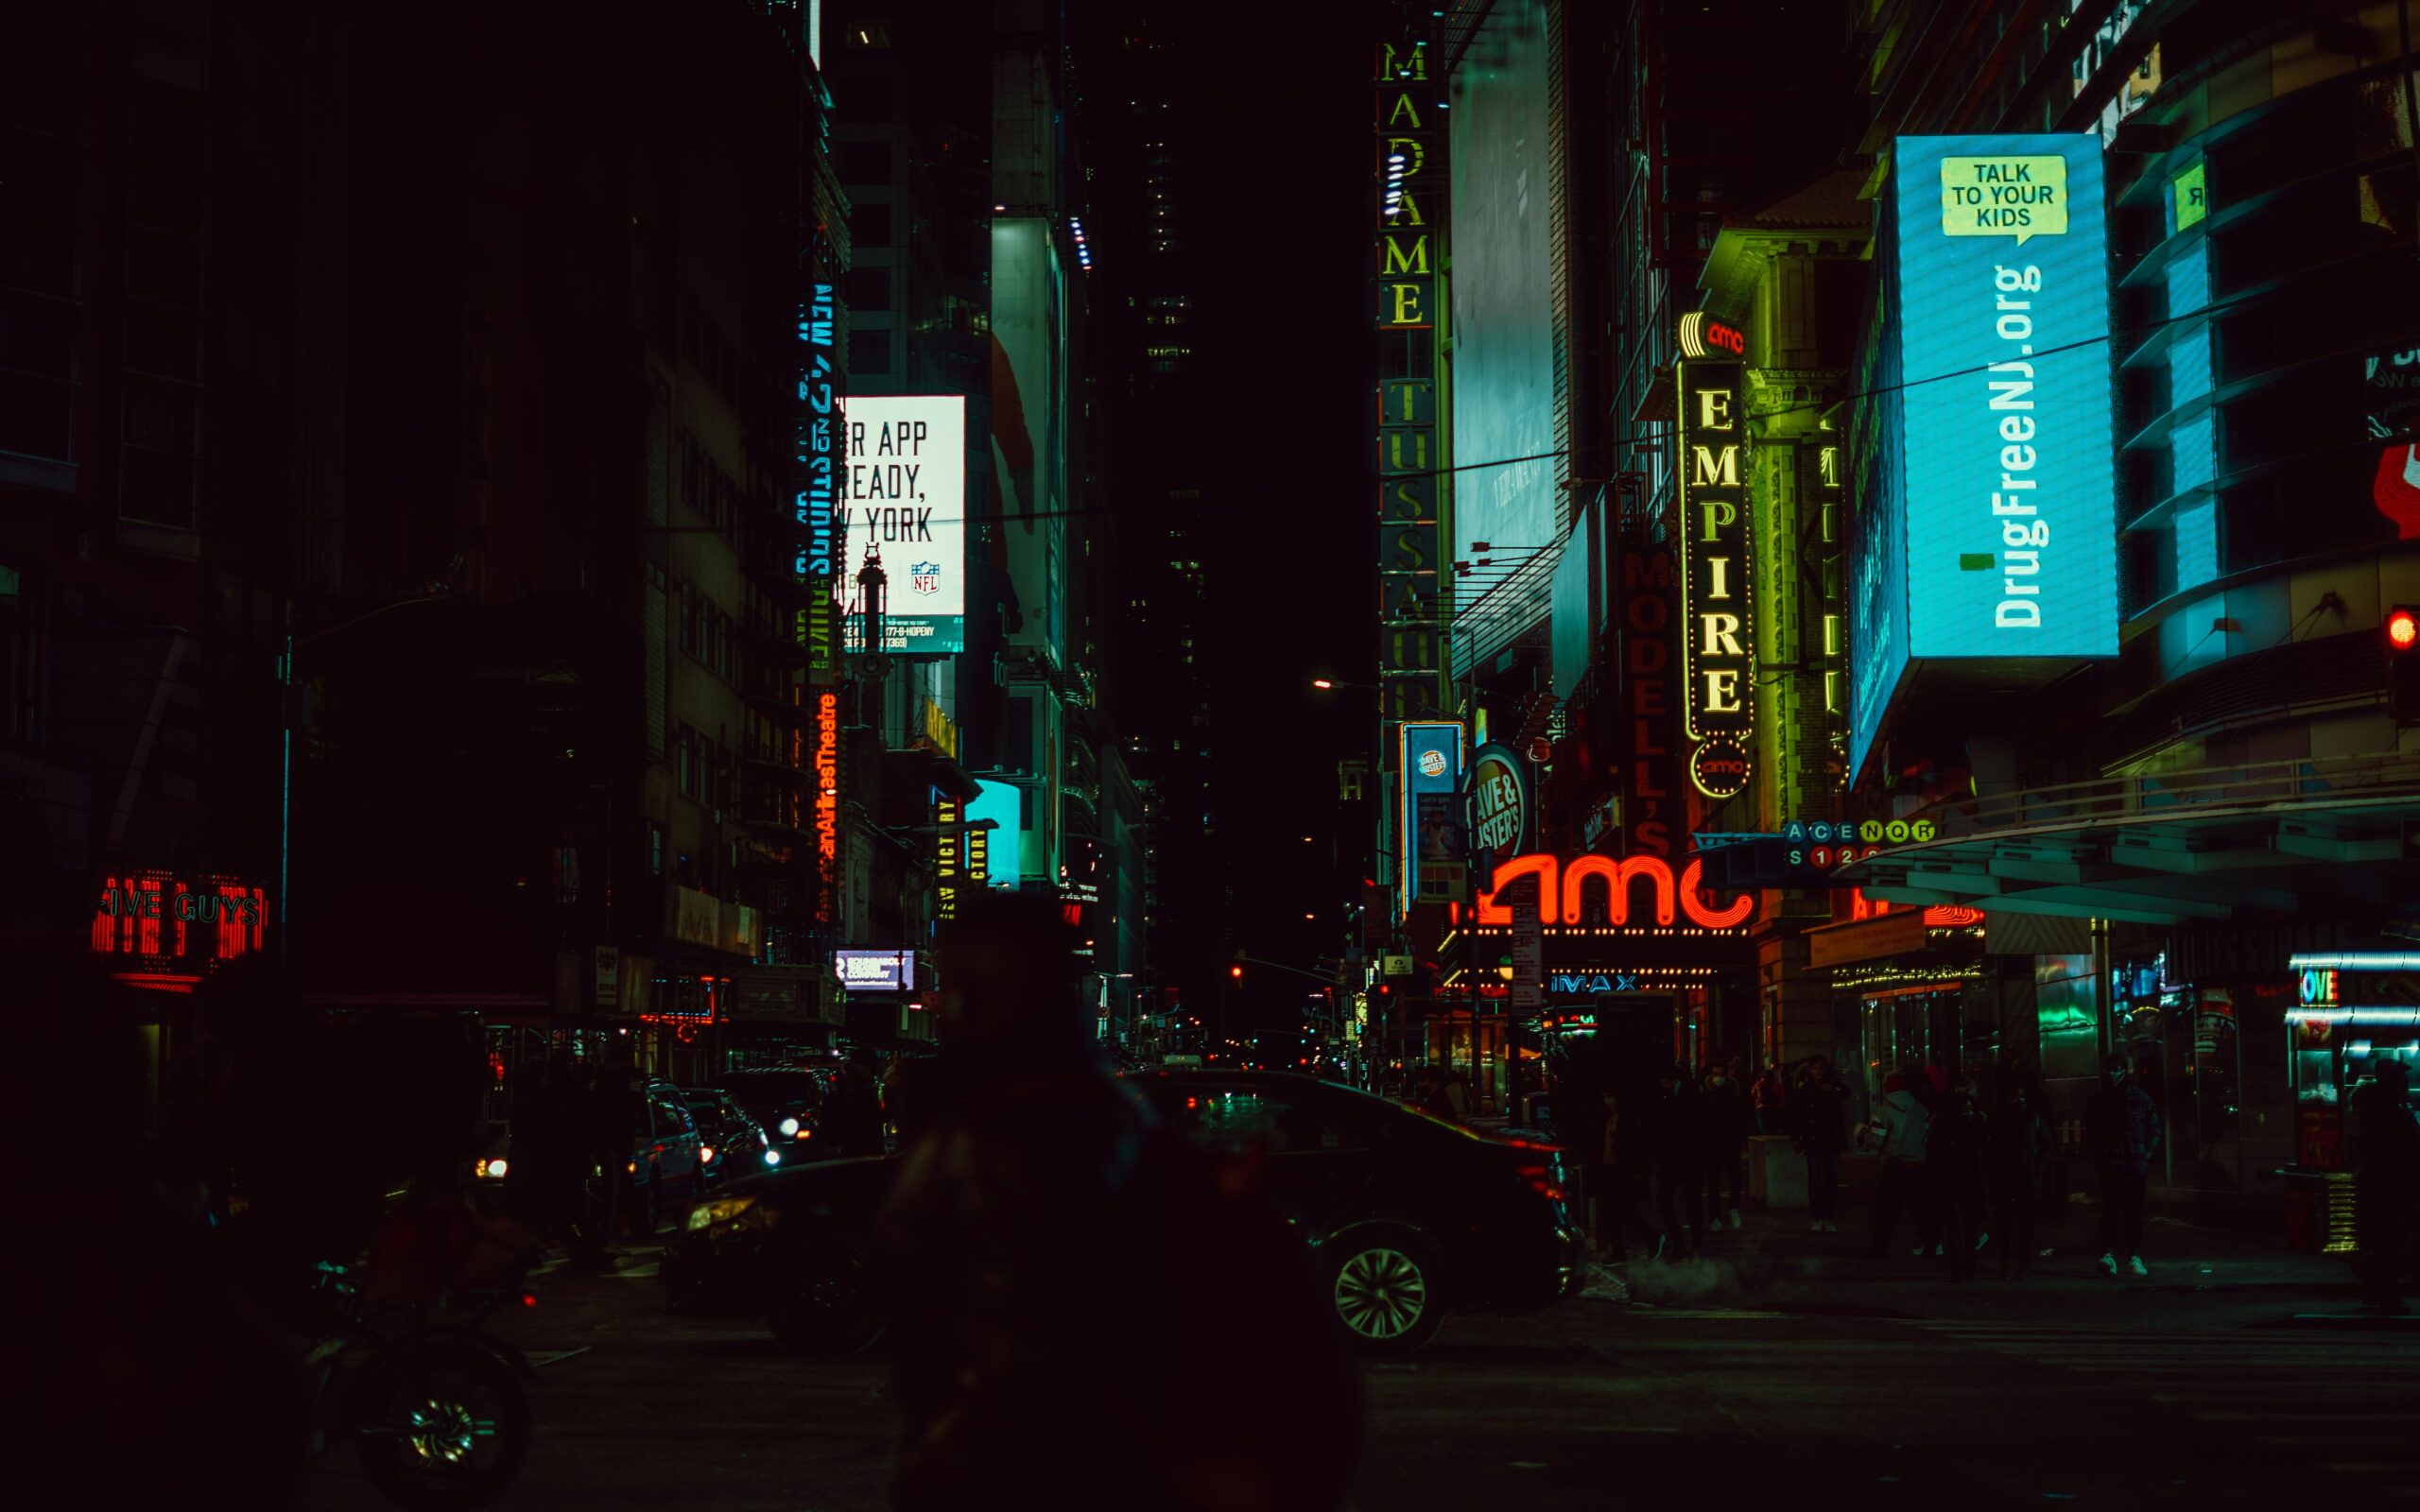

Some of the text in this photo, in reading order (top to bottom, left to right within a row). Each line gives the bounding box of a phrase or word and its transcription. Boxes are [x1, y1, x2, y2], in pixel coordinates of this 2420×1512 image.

[1379, 42, 1430, 324] MADAME
[1974, 164, 2031, 182] TALK
[1952, 185, 2053, 205] TO YOUR
[1977, 209, 2031, 227] KIDS
[1707, 322, 1744, 357] amc
[877, 421, 927, 456] APP
[1988, 265, 2049, 628] DrugFreeNJ.org
[865, 507, 933, 542] YORK
[1691, 388, 1744, 713] EMPIRE
[914, 576, 938, 593] NFL
[939, 801, 955, 877] VICTRY
[1468, 806, 1519, 852] USTER'S
[1789, 824, 1929, 839] A C E N Q R
[1789, 850, 1803, 865] S
[1841, 850, 1853, 863] 2
[1476, 852, 1754, 929] amc
[175, 893, 260, 926] GUYS
[1549, 974, 1638, 993] IMAX
